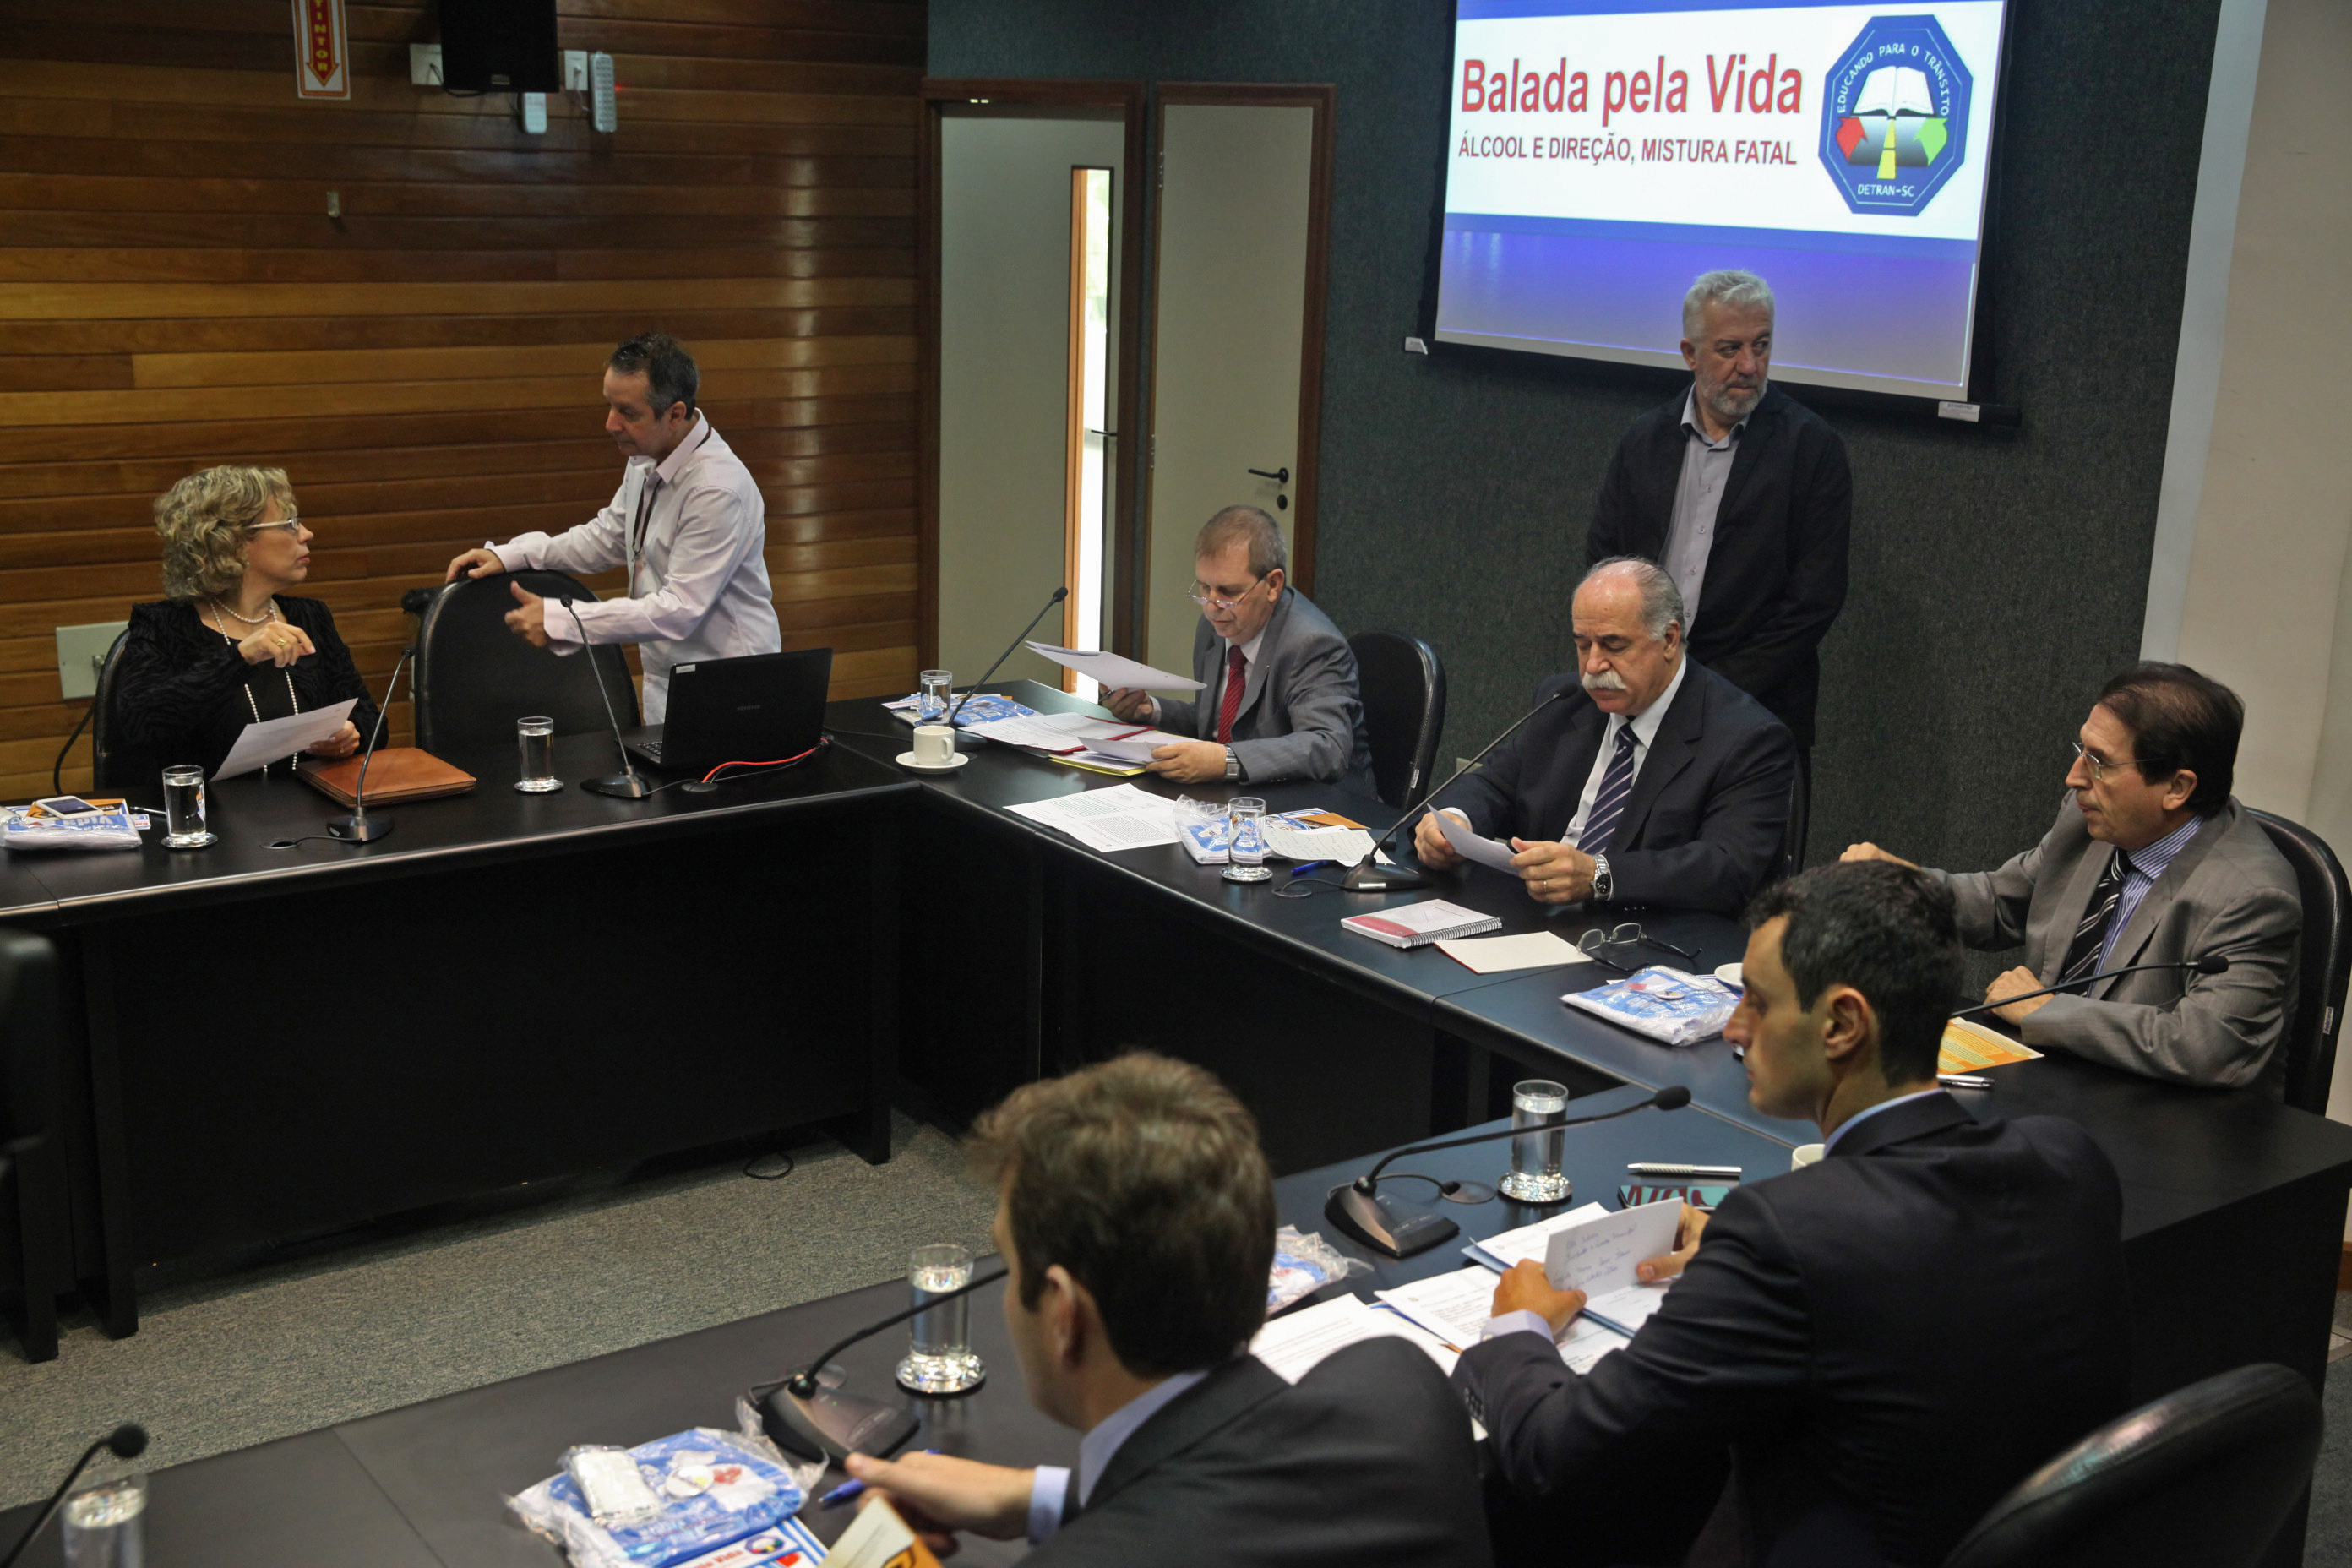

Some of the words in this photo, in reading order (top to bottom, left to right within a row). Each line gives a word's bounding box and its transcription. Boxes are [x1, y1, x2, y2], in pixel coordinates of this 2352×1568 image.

[1462, 57, 1588, 112] Balada
[1602, 55, 1688, 128] pela
[1706, 53, 1802, 114] Vida
[1837, 52, 1874, 114] EDUCANDO
[1878, 43, 1905, 57] PARA
[1910, 45, 1919, 57] O
[1923, 51, 1951, 116] TRÂNSITO
[1458, 129, 1527, 158] ÁLCOOL
[1533, 137, 1544, 159] E
[1549, 132, 1636, 166] DIREÇÃO,
[1642, 138, 1729, 163] MISTURA
[1734, 139, 1797, 165] FATAL
[1857, 184, 1914, 197] DETRAN-SC
